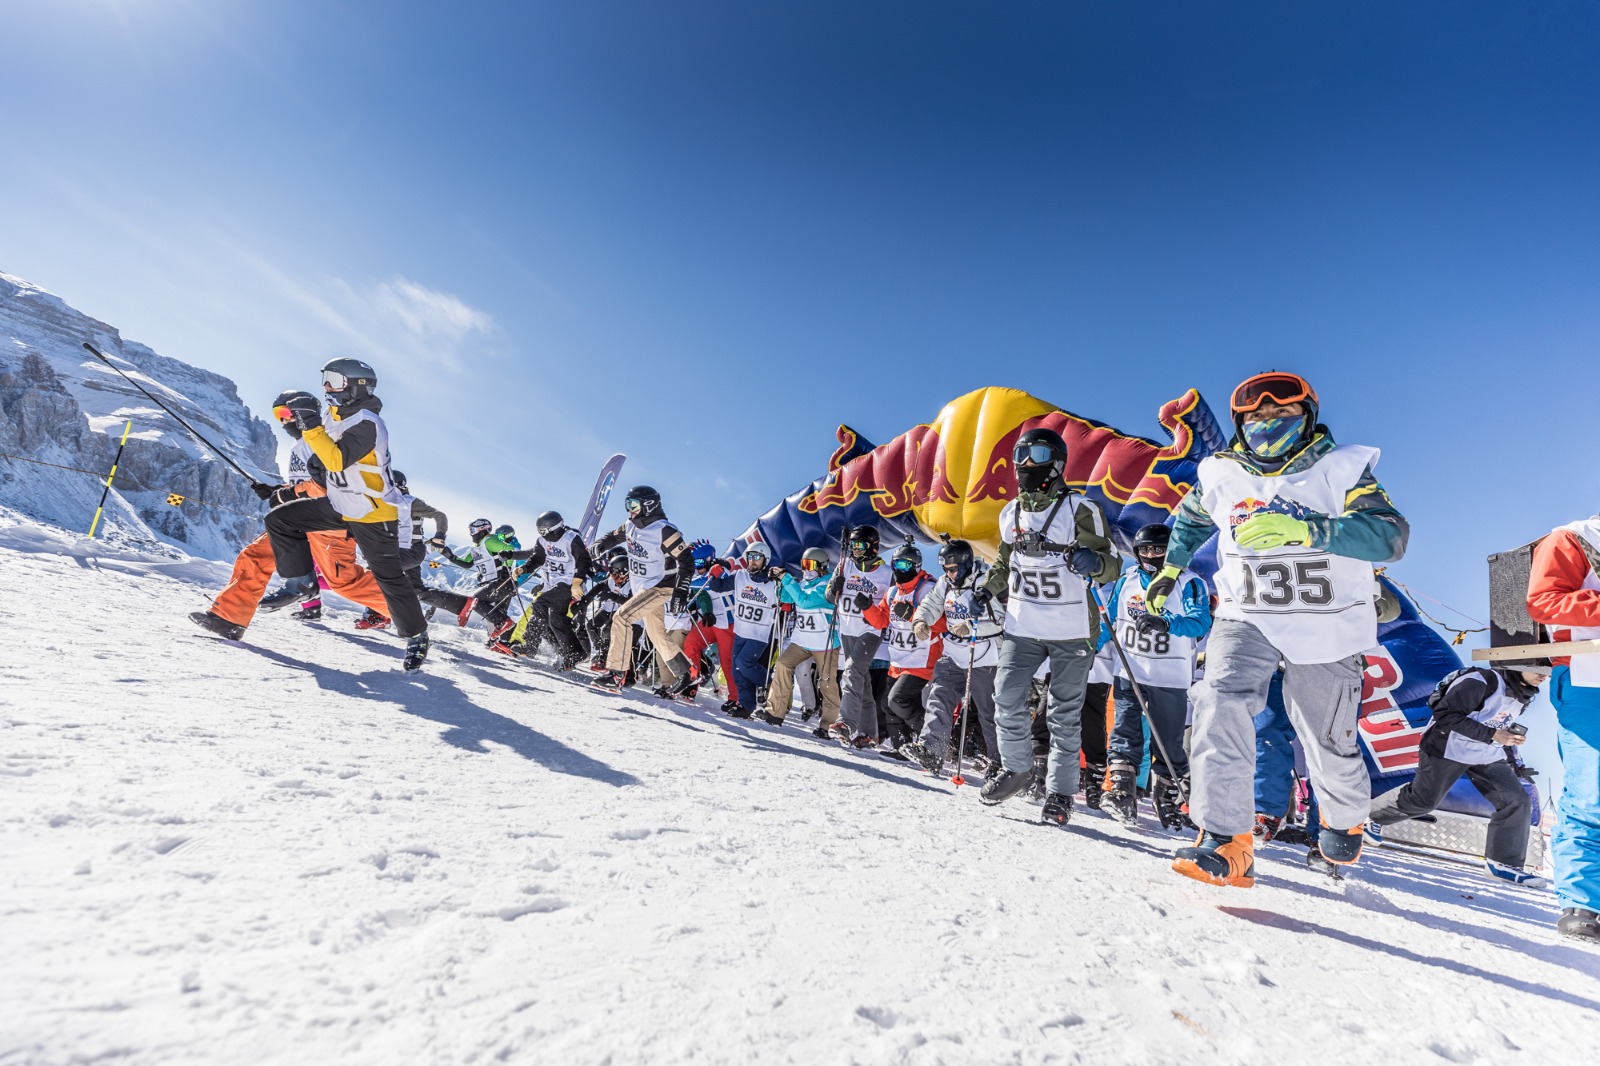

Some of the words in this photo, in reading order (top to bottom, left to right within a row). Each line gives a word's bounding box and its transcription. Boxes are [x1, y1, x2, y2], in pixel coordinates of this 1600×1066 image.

[1241, 559, 1335, 607] 135
[738, 604, 763, 622] 039
[797, 615, 816, 630] 34
[1124, 625, 1170, 656] 058
